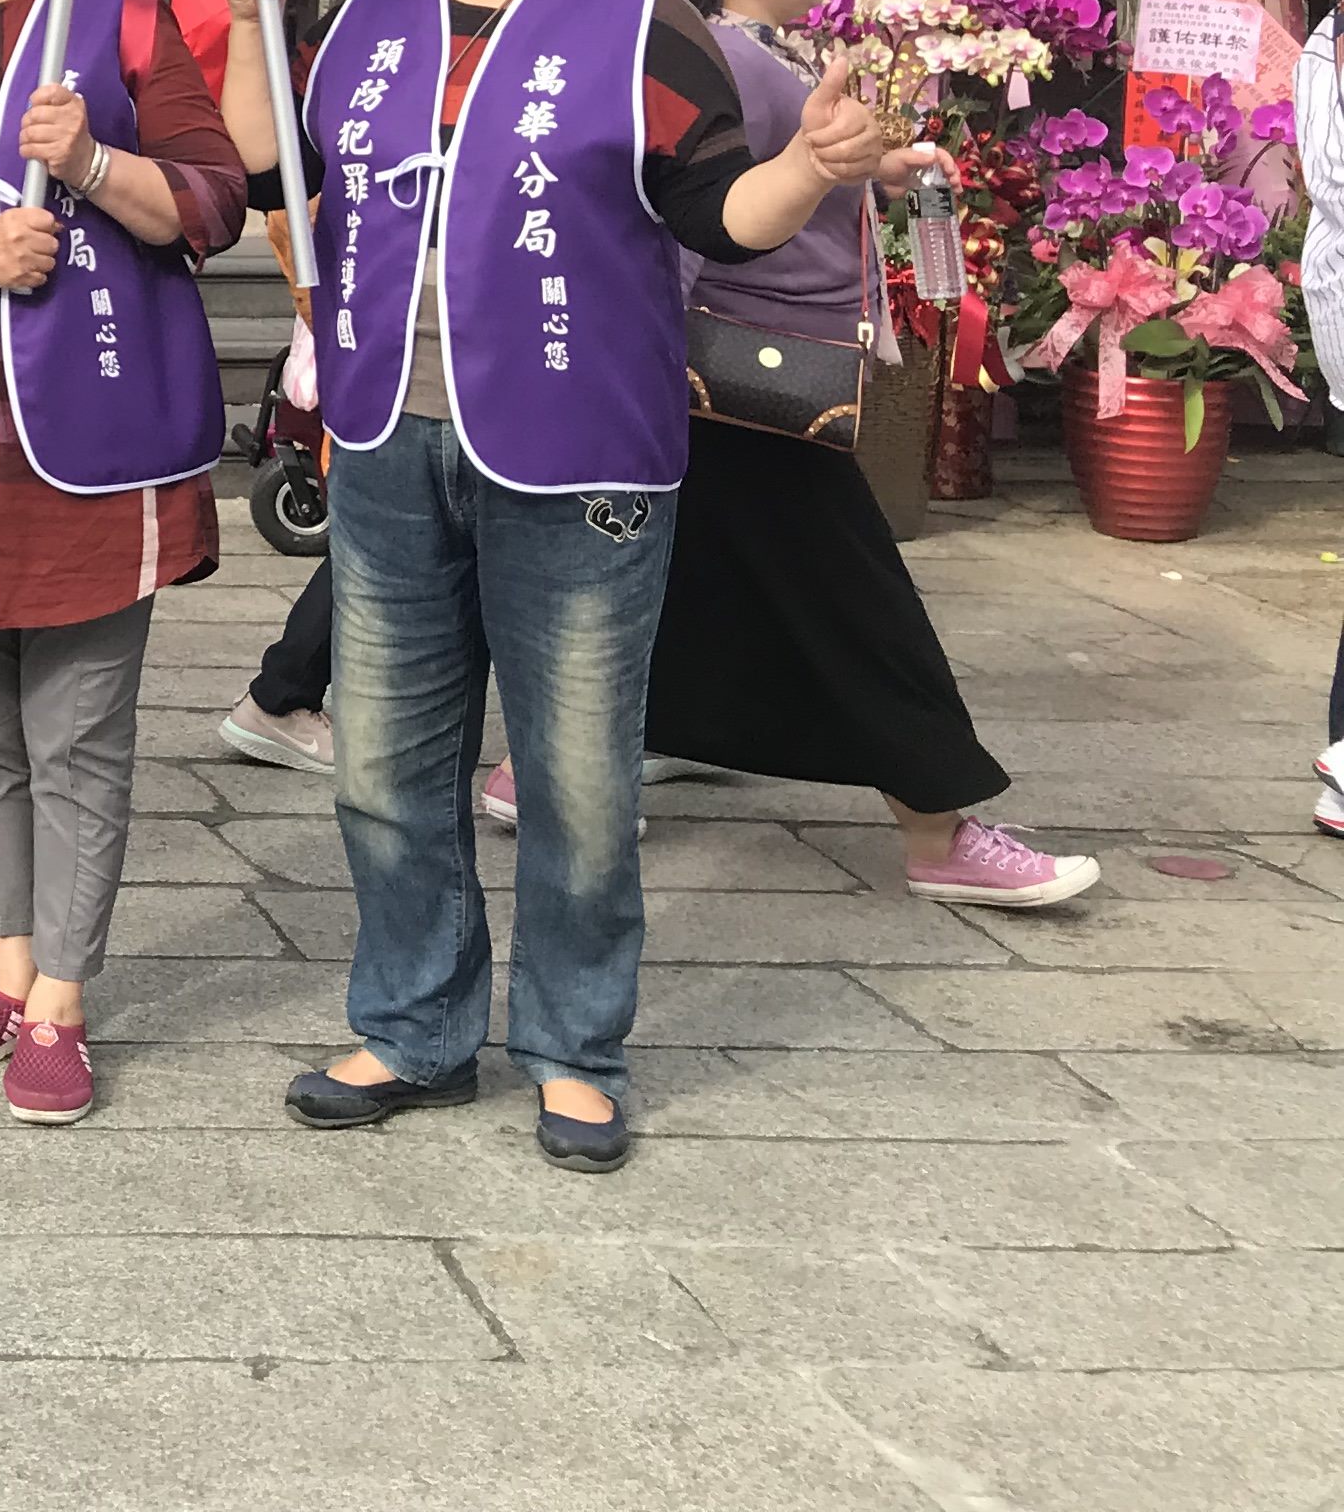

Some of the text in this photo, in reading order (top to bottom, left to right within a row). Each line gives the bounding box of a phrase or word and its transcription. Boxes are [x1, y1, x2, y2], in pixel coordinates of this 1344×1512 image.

[512, 55, 568, 259] 萬華分局
[91, 288, 121, 378] 關心您
[540, 276, 570, 372] 關心您
